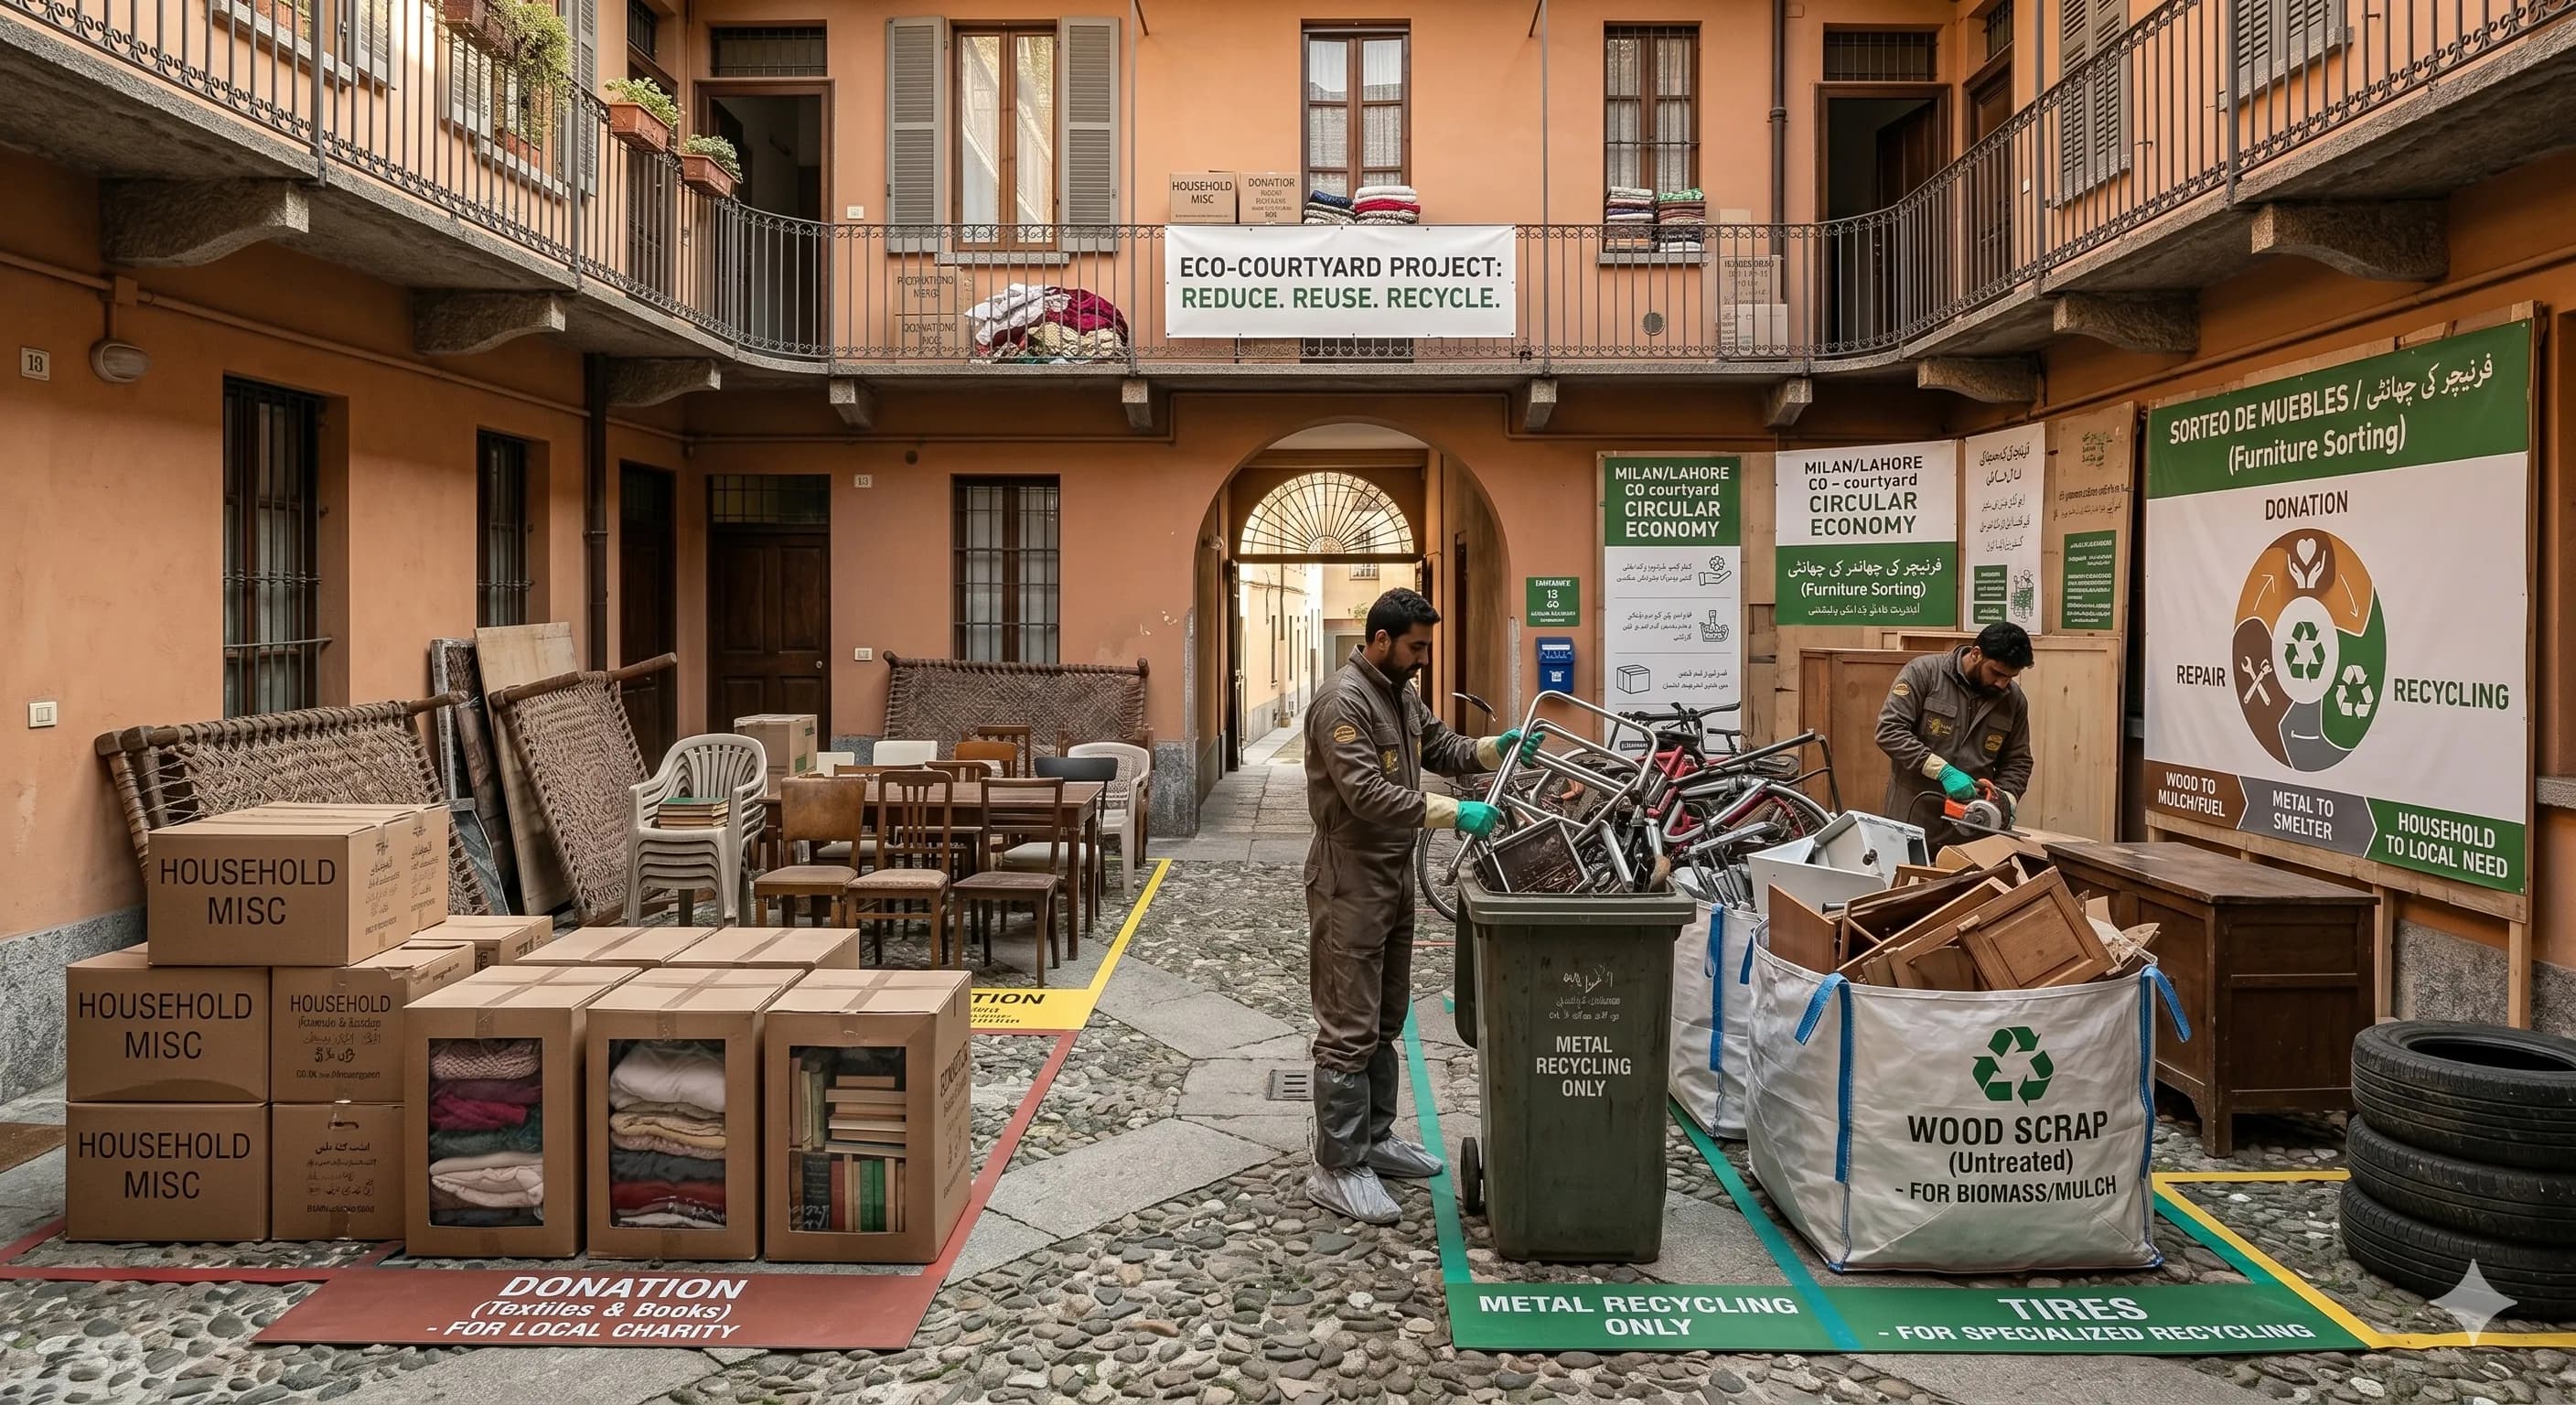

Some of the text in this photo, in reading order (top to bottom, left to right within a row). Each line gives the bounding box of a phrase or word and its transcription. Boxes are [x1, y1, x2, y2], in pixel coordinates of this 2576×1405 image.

[1172, 181, 1232, 191] HOUSEHOLD
[1191, 194, 1214, 204] MISC
[1180, 256, 1502, 278] ECO-COURTYARD PROJECT:
[1182, 287, 1500, 309] REDUCE. REUSE. RECYCLE.
[27, 354, 43, 372] 13
[2441, 352, 2494, 397] فرنیچر
[2420, 362, 2440, 400] کی
[2367, 375, 2417, 411] چھانٹی
[2260, 383, 2349, 428] MUEBLES
[2169, 410, 2230, 445] SORTEO
[2234, 403, 2258, 433] DE
[2228, 413, 2407, 477] (Furniture Sorting)
[1615, 466, 1730, 481] MILAN/LAHORE
[1805, 456, 1923, 475] MILAN/LAHORE
[1625, 483, 1719, 499] CO courtyard
[1809, 477, 1828, 490] CO
[1843, 472, 1917, 490] courtyard
[1625, 500, 1721, 518] CIRCULAR
[1809, 491, 1917, 513] CIRCULAR
[2265, 489, 2349, 520] DONATION
[1626, 520, 1720, 538] ECONOMY
[1811, 515, 1917, 536] ECONOMY
[1829, 560, 1844, 577] کی
[1886, 559, 1900, 576] کی
[1546, 589, 1558, 599] 13
[1800, 581, 1927, 600] (Furniture Sorting)
[2176, 664, 2226, 687] REPAIR
[2393, 678, 2509, 710] RECYCLING
[2166, 771, 2216, 795] WOOD TO
[2158, 788, 2226, 817] MULCH/FUEL
[2272, 790, 2334, 818] METAL TO
[2273, 812, 2333, 841] SMELTER
[2398, 811, 2496, 850] HOUSEHOLD
[2385, 834, 2508, 878] TO LOCAL NEED
[160, 858, 336, 885] HOUSEHOLD
[208, 896, 285, 925] MISC
[79, 992, 252, 1020] HOUSEHOLD
[290, 995, 391, 1013] HOUSEHOLD
[125, 1031, 202, 1059] MISC
[1556, 1035, 1613, 1053] METAL
[1537, 1057, 1631, 1075] RECYCLING
[1562, 1079, 1606, 1097] ONLY
[1907, 1110, 2109, 1144] WOOD SCRAP
[79, 1132, 251, 1159] HOUSEHOLD
[1948, 1148, 2073, 1177] (Untreated)
[124, 1171, 200, 1199] MISC
[1910, 1182, 1950, 1203] FOR
[1957, 1174, 2117, 1204] BIOMASS/MULCH
[499, 1276, 748, 1299] DONATION
[470, 1300, 731, 1323] (Textiles & Books)
[1479, 1295, 1799, 1314] METAL RECYCLING
[1997, 1297, 2149, 1321] TIRES
[443, 1322, 507, 1336] FOR
[509, 1322, 601, 1337] LOCAL
[611, 1323, 741, 1339] CHARITY
[1605, 1318, 1693, 1336] ONLY
[1895, 1325, 1959, 1341] FOR
[1959, 1325, 2145, 1342] SPECIALIZED
[2146, 1323, 2317, 1340] RECYCLING
